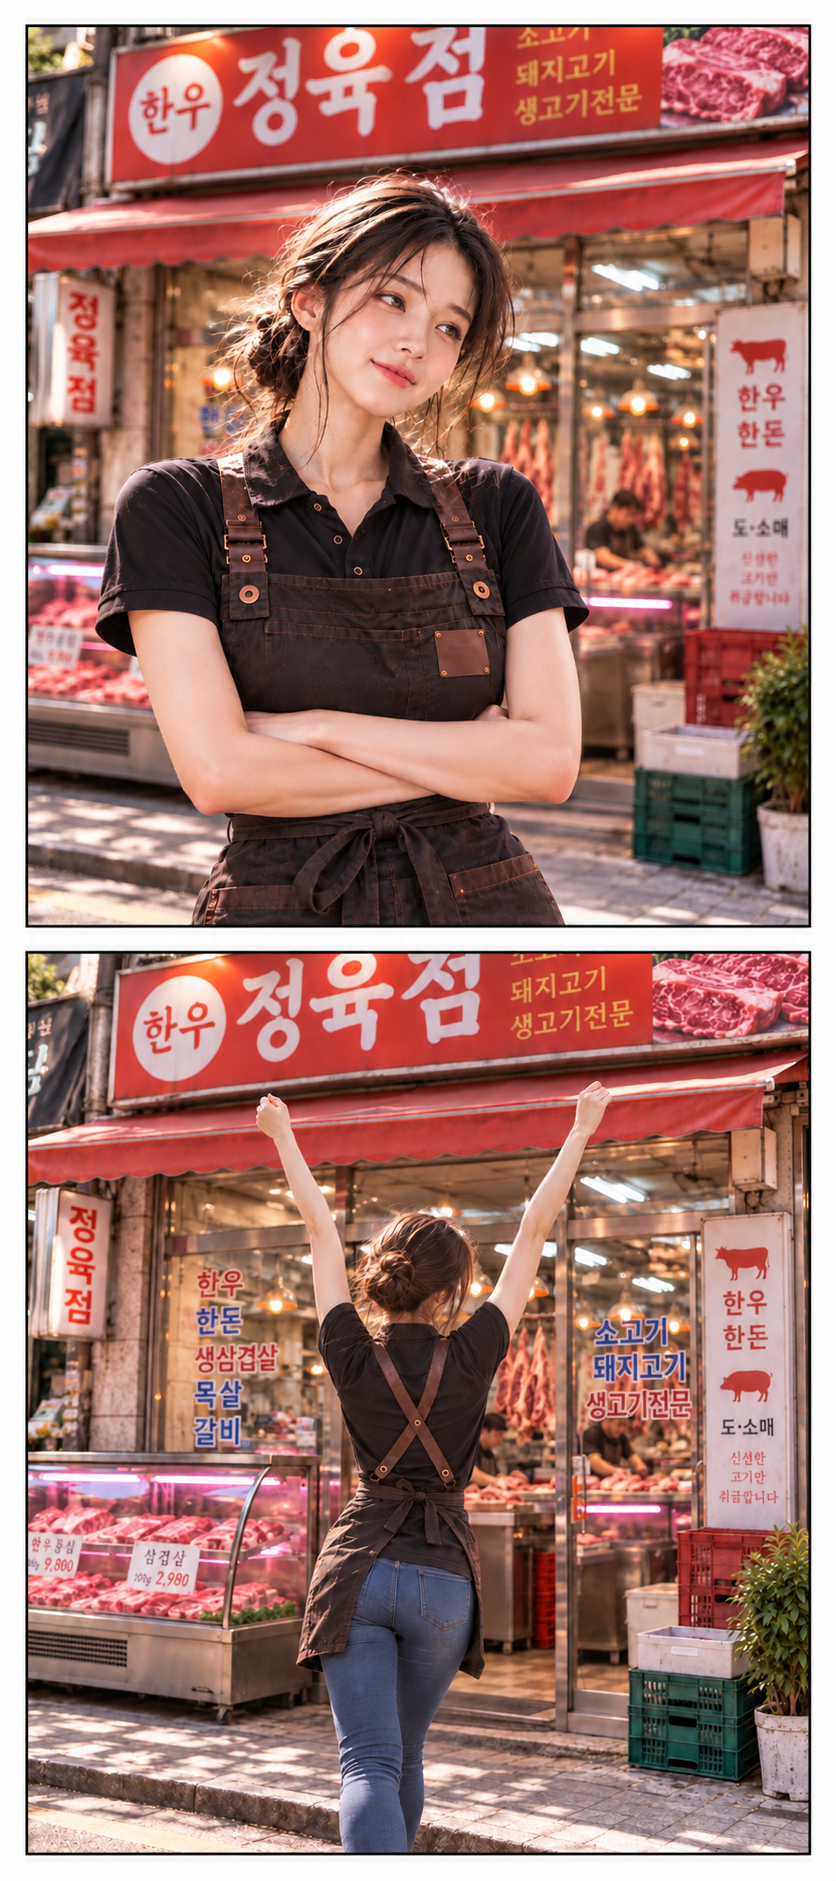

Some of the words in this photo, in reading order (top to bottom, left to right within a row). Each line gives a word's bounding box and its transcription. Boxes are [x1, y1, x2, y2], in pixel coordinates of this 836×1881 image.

[515, 48, 615, 87] 돼지고기
[140, 82, 211, 136] 한우
[232, 27, 486, 147] 정육점
[514, 83, 642, 126] 생고기전문
[67, 290, 99, 415] 정육점
[737, 384, 785, 412] 한우
[737, 420, 785, 448] 한돈
[510, 966, 606, 1003] 돼지고기
[143, 1001, 216, 1056] 한우
[236, 953, 481, 1063] 정육점
[510, 999, 633, 1040] 생고기전문
[64, 1206, 98, 1325] 정육점
[197, 1270, 244, 1298] 한우
[723, 1290, 768, 1316] 한우
[196, 1306, 242, 1335] 한돈
[594, 1316, 668, 1346] 소고기
[723, 1325, 769, 1351] 한돈
[194, 1343, 279, 1374] 생삼겹살
[593, 1351, 686, 1382] 돼지고기
[194, 1379, 242, 1410] 목살
[586, 1388, 692, 1421] 생고기전문
[193, 1416, 241, 1446] 갈비
[720, 1417, 774, 1437] 도·소매
[44, 1557, 74, 1573] 9,800
[155, 1570, 190, 1587] 2,980
